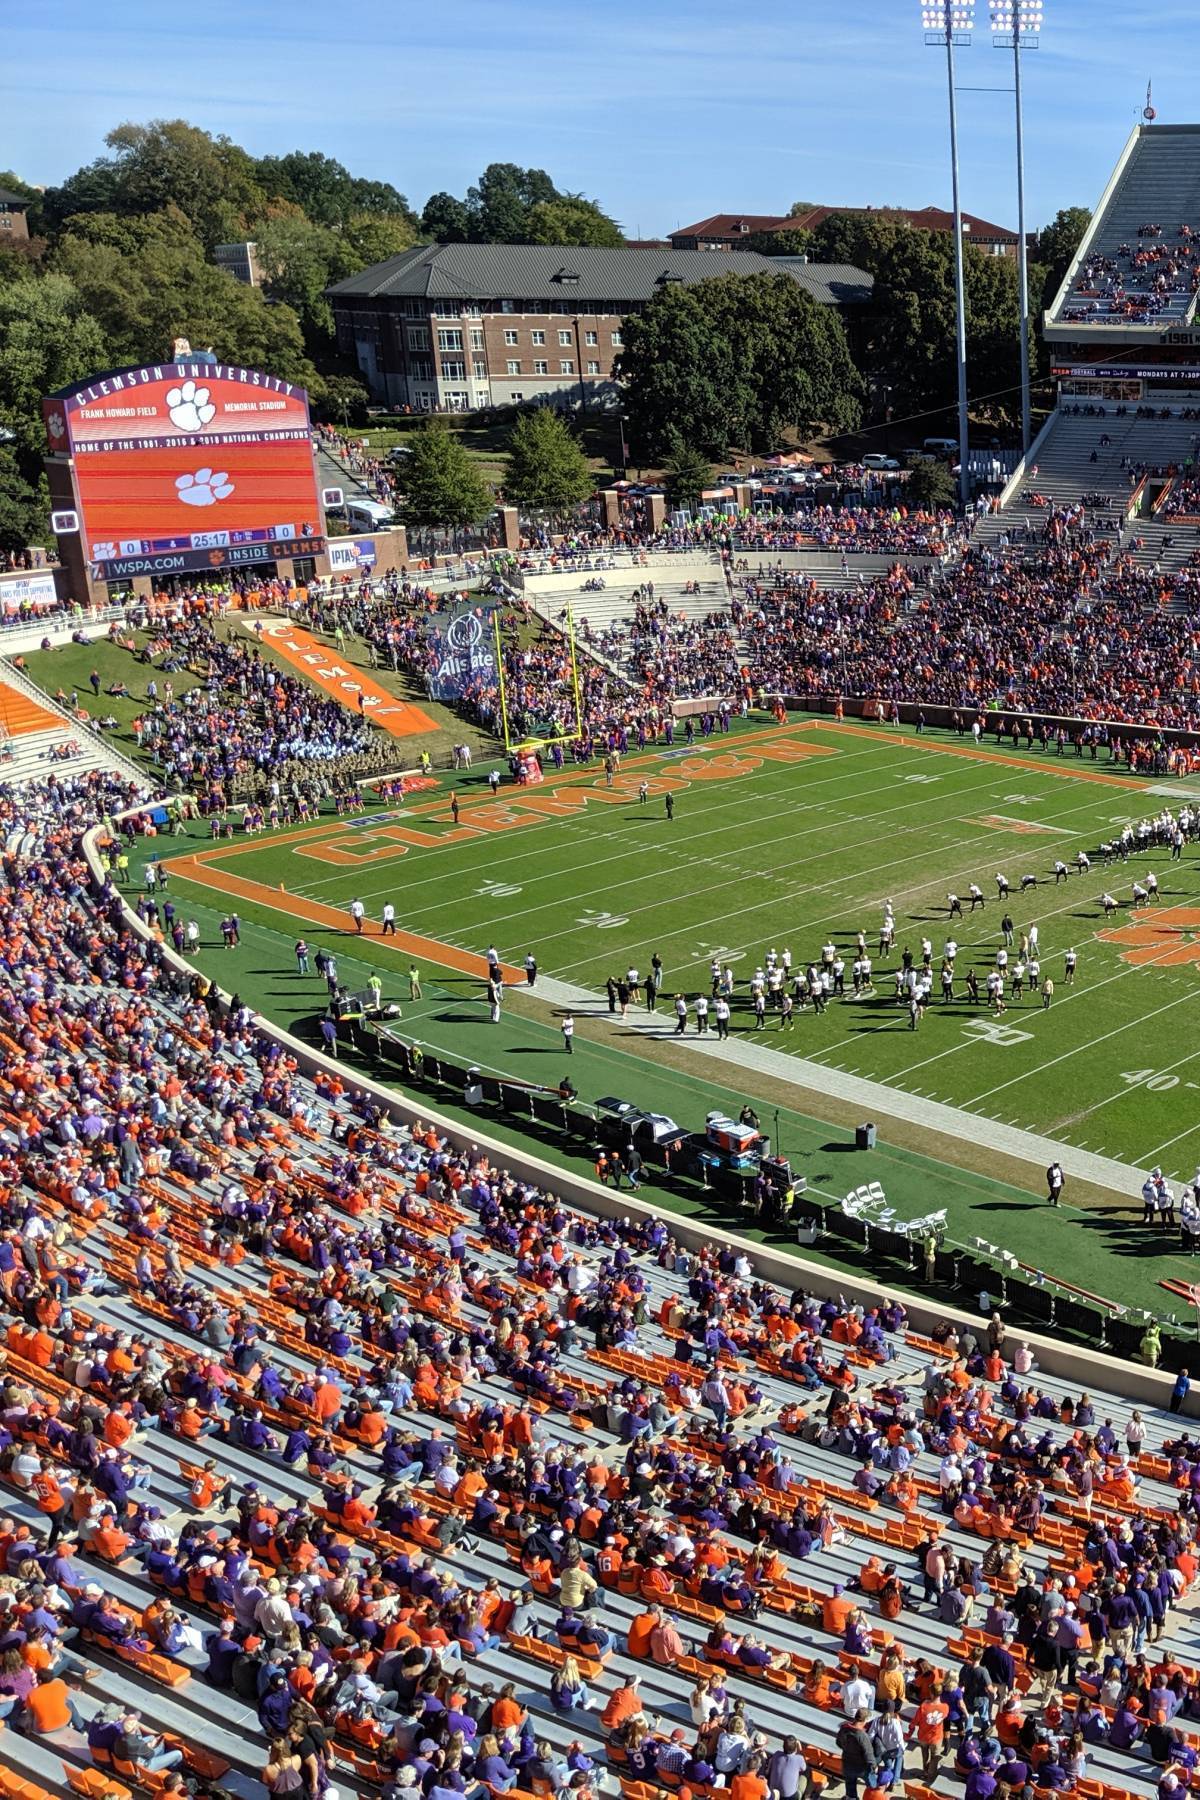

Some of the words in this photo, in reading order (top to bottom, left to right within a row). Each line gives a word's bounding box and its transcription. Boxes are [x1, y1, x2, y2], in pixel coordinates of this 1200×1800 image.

[1168, 333, 1193, 344] 1981
[76, 367, 162, 406] CLEMSON
[178, 364, 293, 396] UNIVERSITY
[80, 408, 105, 419] FRANK
[106, 407, 135, 417] HOWARD
[137, 406, 157, 416] FIELD
[224, 401, 258, 412] MEMORIAL
[259, 400, 286, 411] STADIUM
[75, 443, 100, 452] HOME
[104, 442, 114, 451] OF
[118, 441, 134, 450] THE
[166, 438, 186, 447] 2016
[200, 435, 220, 444] 2018
[223, 433, 261, 443] NATIONAL
[264, 430, 308, 441] CHAMPIONS
[127, 543, 134, 553] 0
[193, 534, 227, 548] 25:17
[282, 527, 289, 537] 0
[114, 557, 184, 575] WSPA.COM
[228, 546, 268, 560] INSIDE
[438, 651, 493, 677] Allsate
[472, 883, 522, 897] 10
[575, 912, 630, 929] 20
[691, 946, 747, 962] 30
[960, 1019, 1035, 1046] 50
[1120, 1068, 1180, 1091] 40
